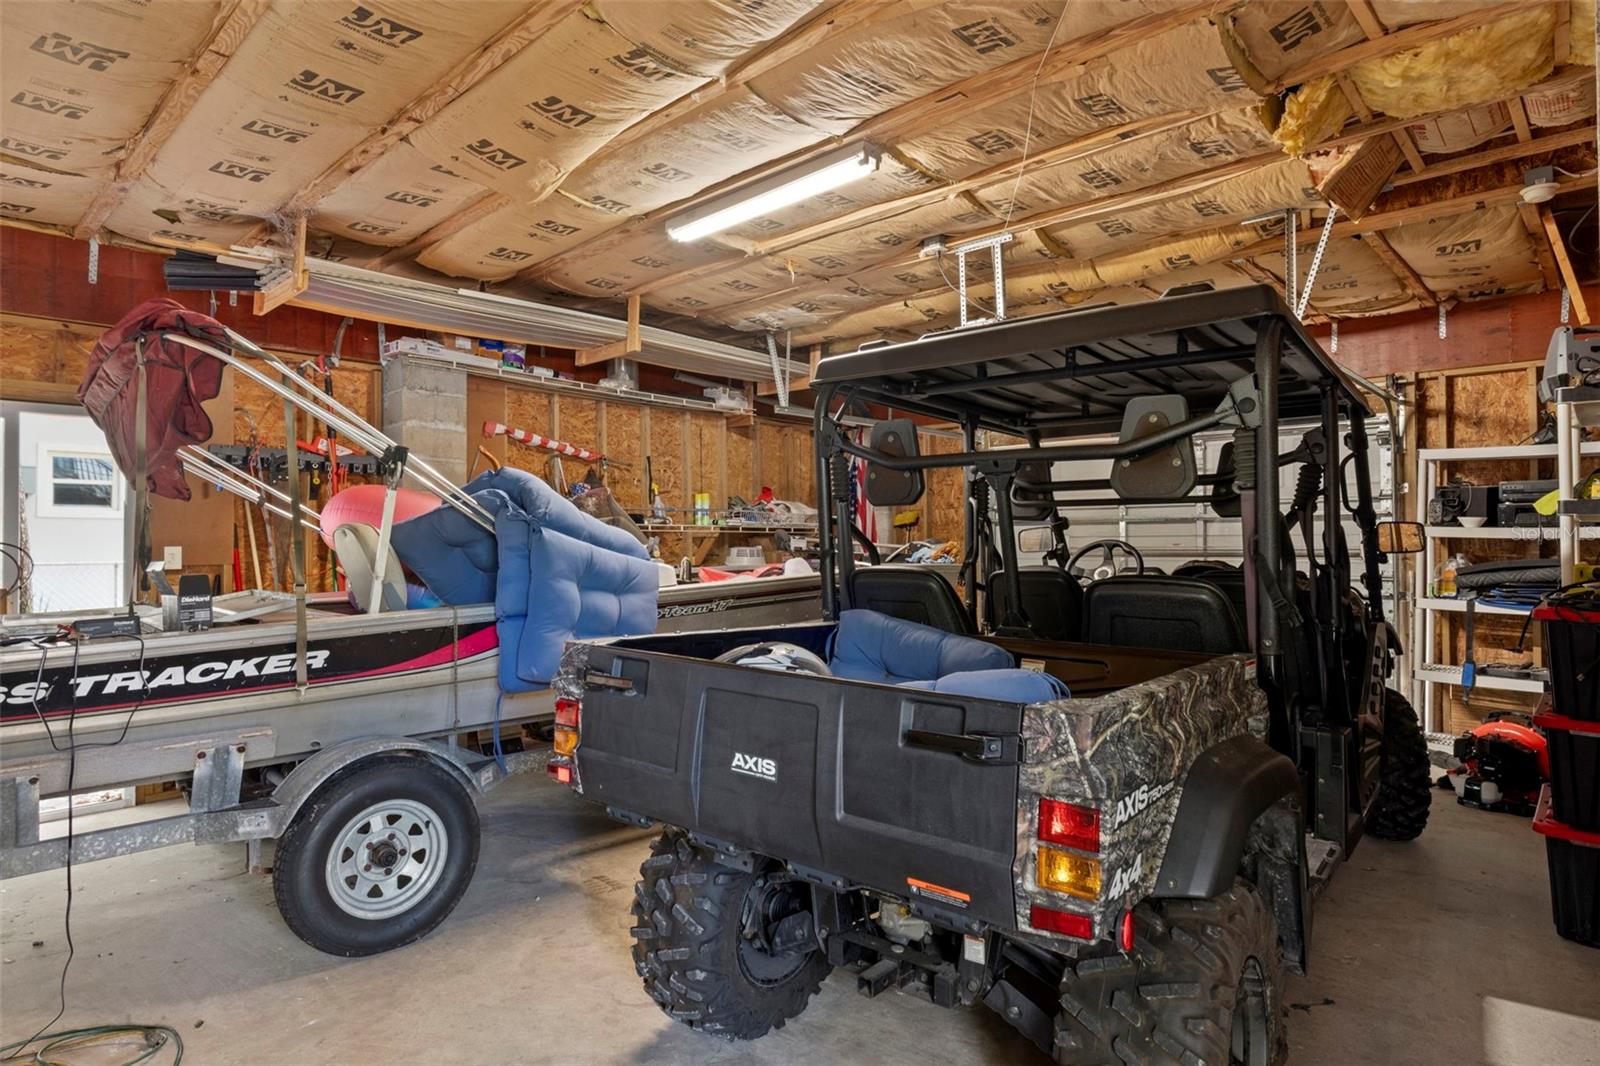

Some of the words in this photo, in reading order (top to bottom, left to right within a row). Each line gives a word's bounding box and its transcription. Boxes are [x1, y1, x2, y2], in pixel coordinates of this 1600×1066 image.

[340, 6, 423, 44] JM
[30, 34, 117, 72] JM
[289, 69, 365, 103] JM
[10, 91, 90, 119] JM
[531, 95, 597, 128] JM
[241, 120, 309, 143] JM
[466, 138, 527, 169] JM
[208, 161, 271, 182] JM
[385, 191, 439, 208] JM
[535, 219, 581, 236] JM
[488, 247, 534, 261] JM
[1435, 239, 1481, 257] JM
[69, 650, 330, 698] TRACKER
[731, 752, 776, 775] AXIS
[1114, 784, 1148, 830] AXIS
[1108, 853, 1142, 900] 4x4
